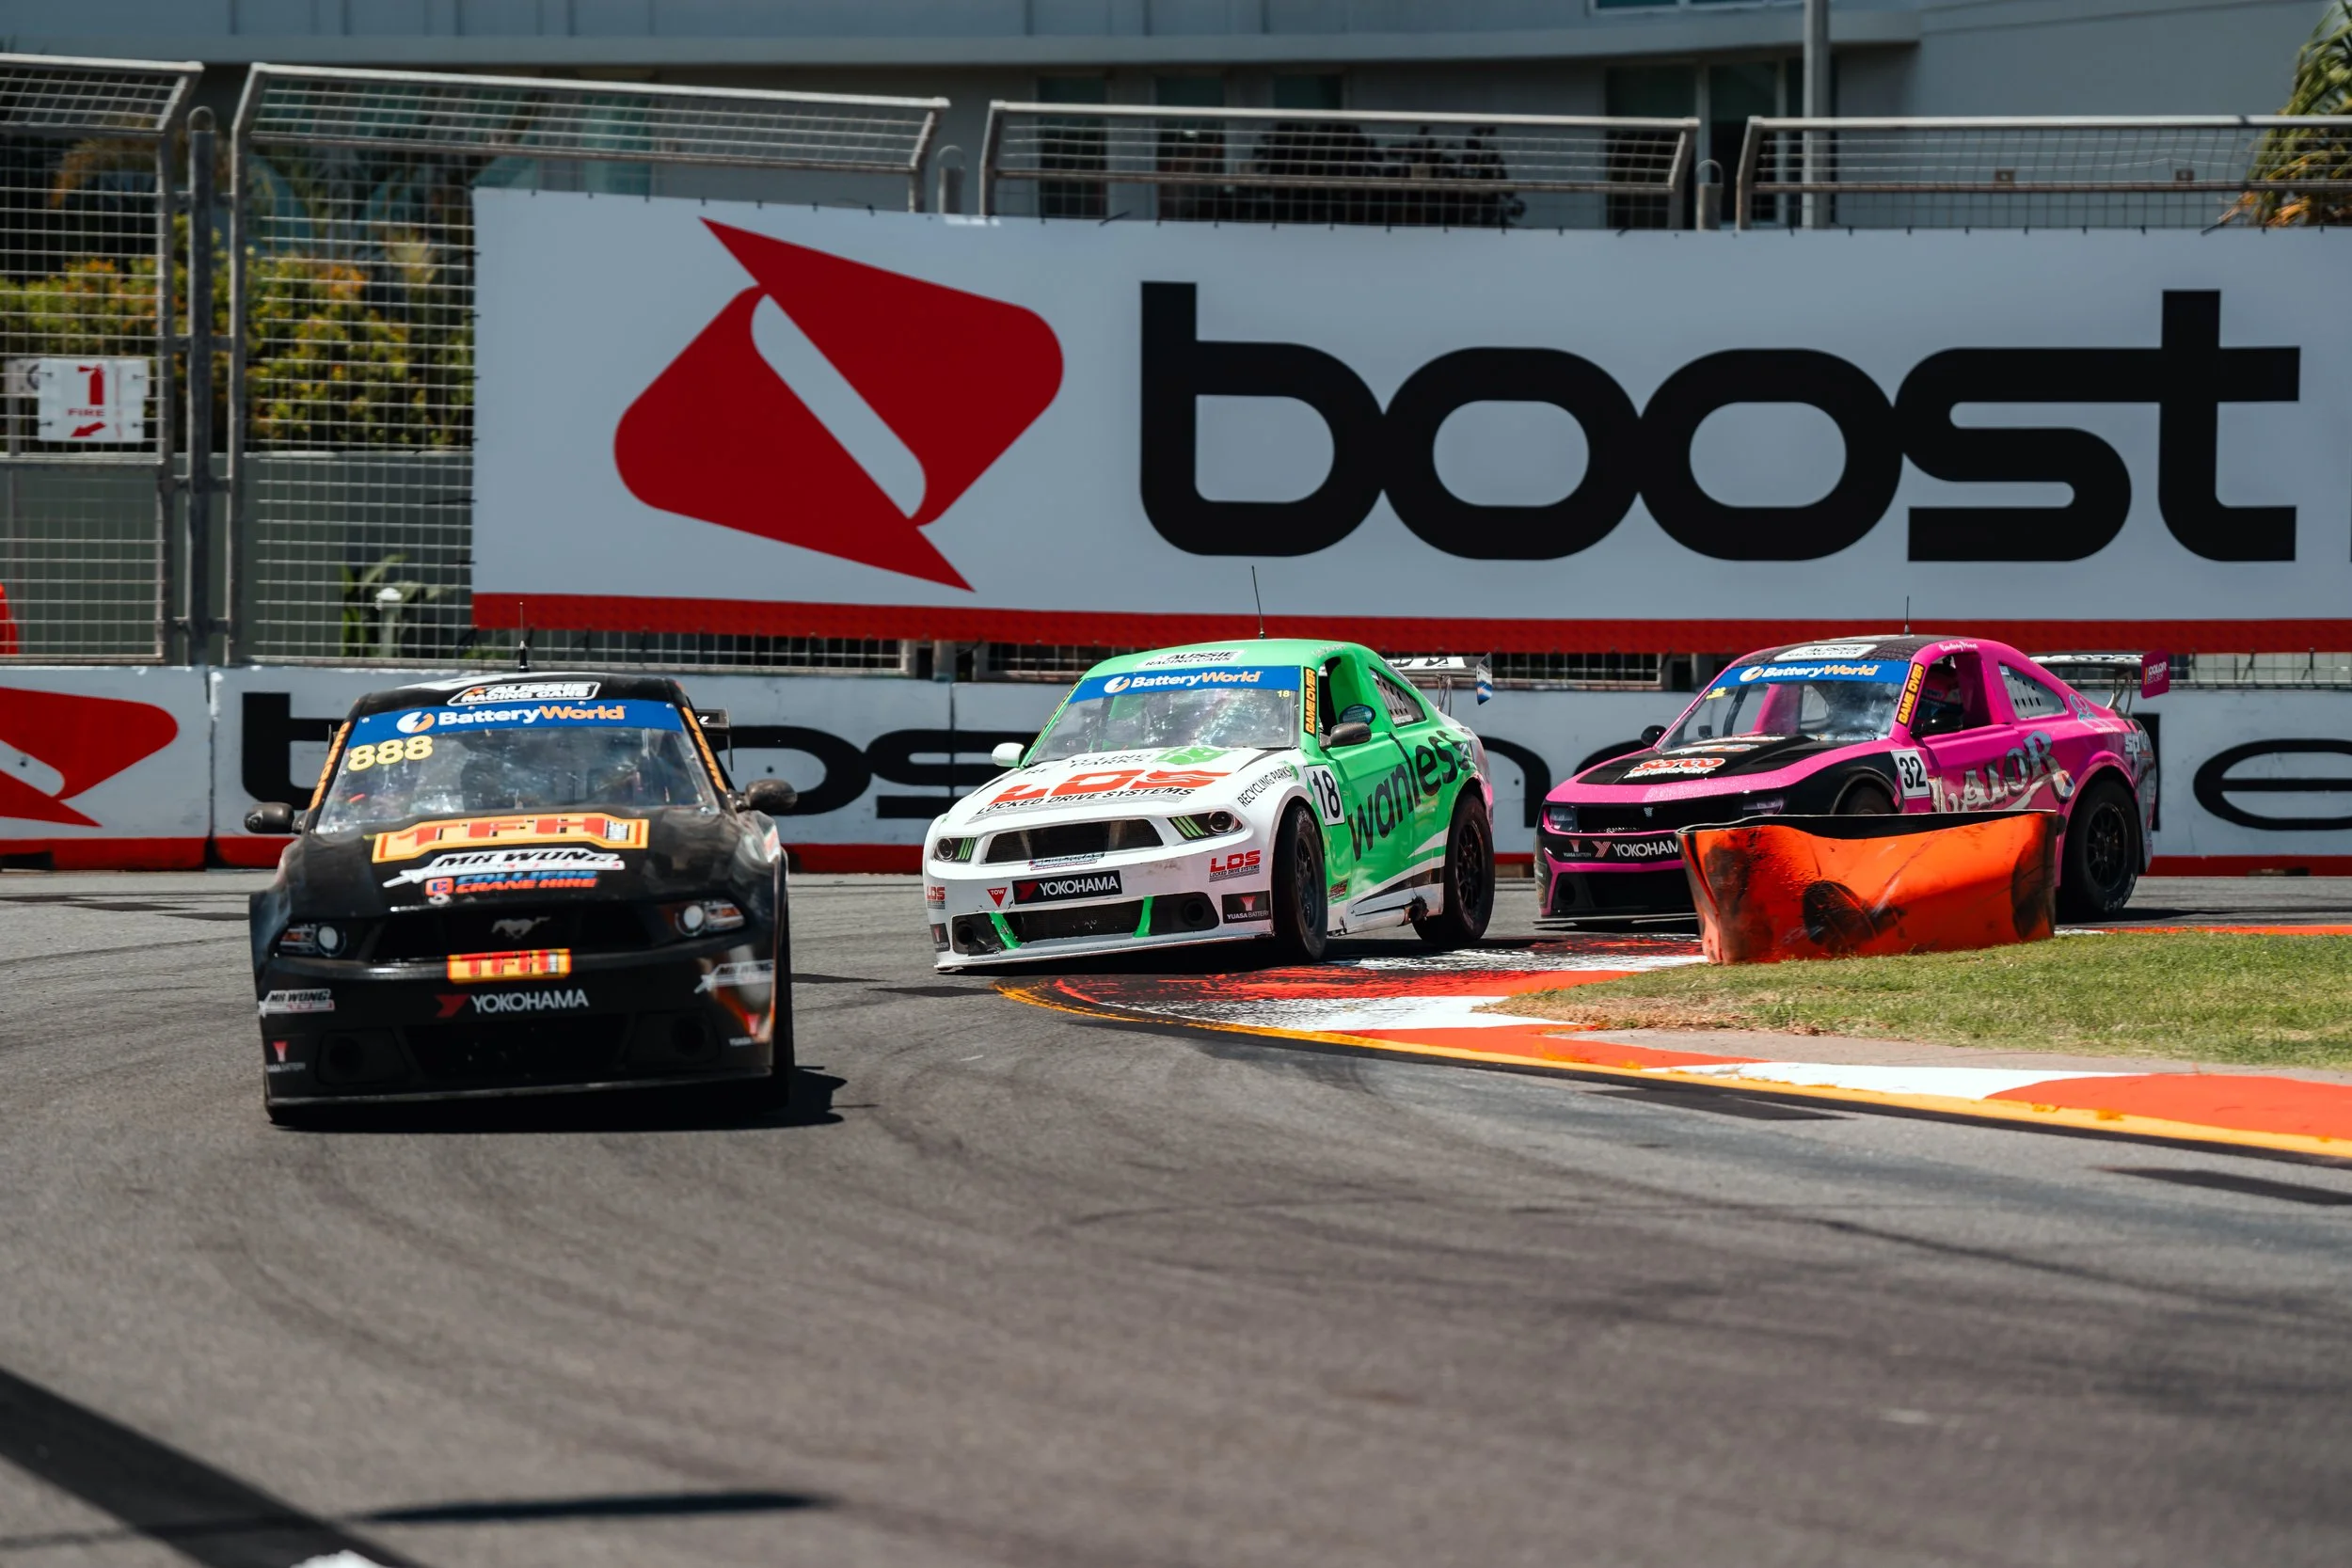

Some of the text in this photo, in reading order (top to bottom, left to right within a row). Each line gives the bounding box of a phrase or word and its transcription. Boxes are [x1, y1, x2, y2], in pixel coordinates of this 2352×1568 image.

[68, 408, 105, 417] FIRE
[1141, 281, 2300, 562] boost
[1166, 651, 1238, 660] AUSSIE
[1131, 671, 1261, 688] BatteryWorld
[1761, 664, 1880, 678] BatteryWorld
[1898, 663, 1925, 724] GAME OVER
[438, 705, 625, 726] BatteryWorld
[348, 736, 433, 771] 888
[1899, 756, 1927, 789] 32
[988, 769, 1232, 806] LDS
[1237, 766, 1292, 807] RECYCLING PARKS
[1312, 770, 1341, 818] 18
[976, 786, 1196, 816] LOCKED DRIVE SYSTEMS
[1613, 840, 1678, 857] YOKOHAM
[1210, 849, 1261, 873] LDS
[455, 879, 597, 894] CRANE HIRE
[1039, 876, 1120, 895] YOKOHAMA
[471, 989, 590, 1014] YOKOHAMA
